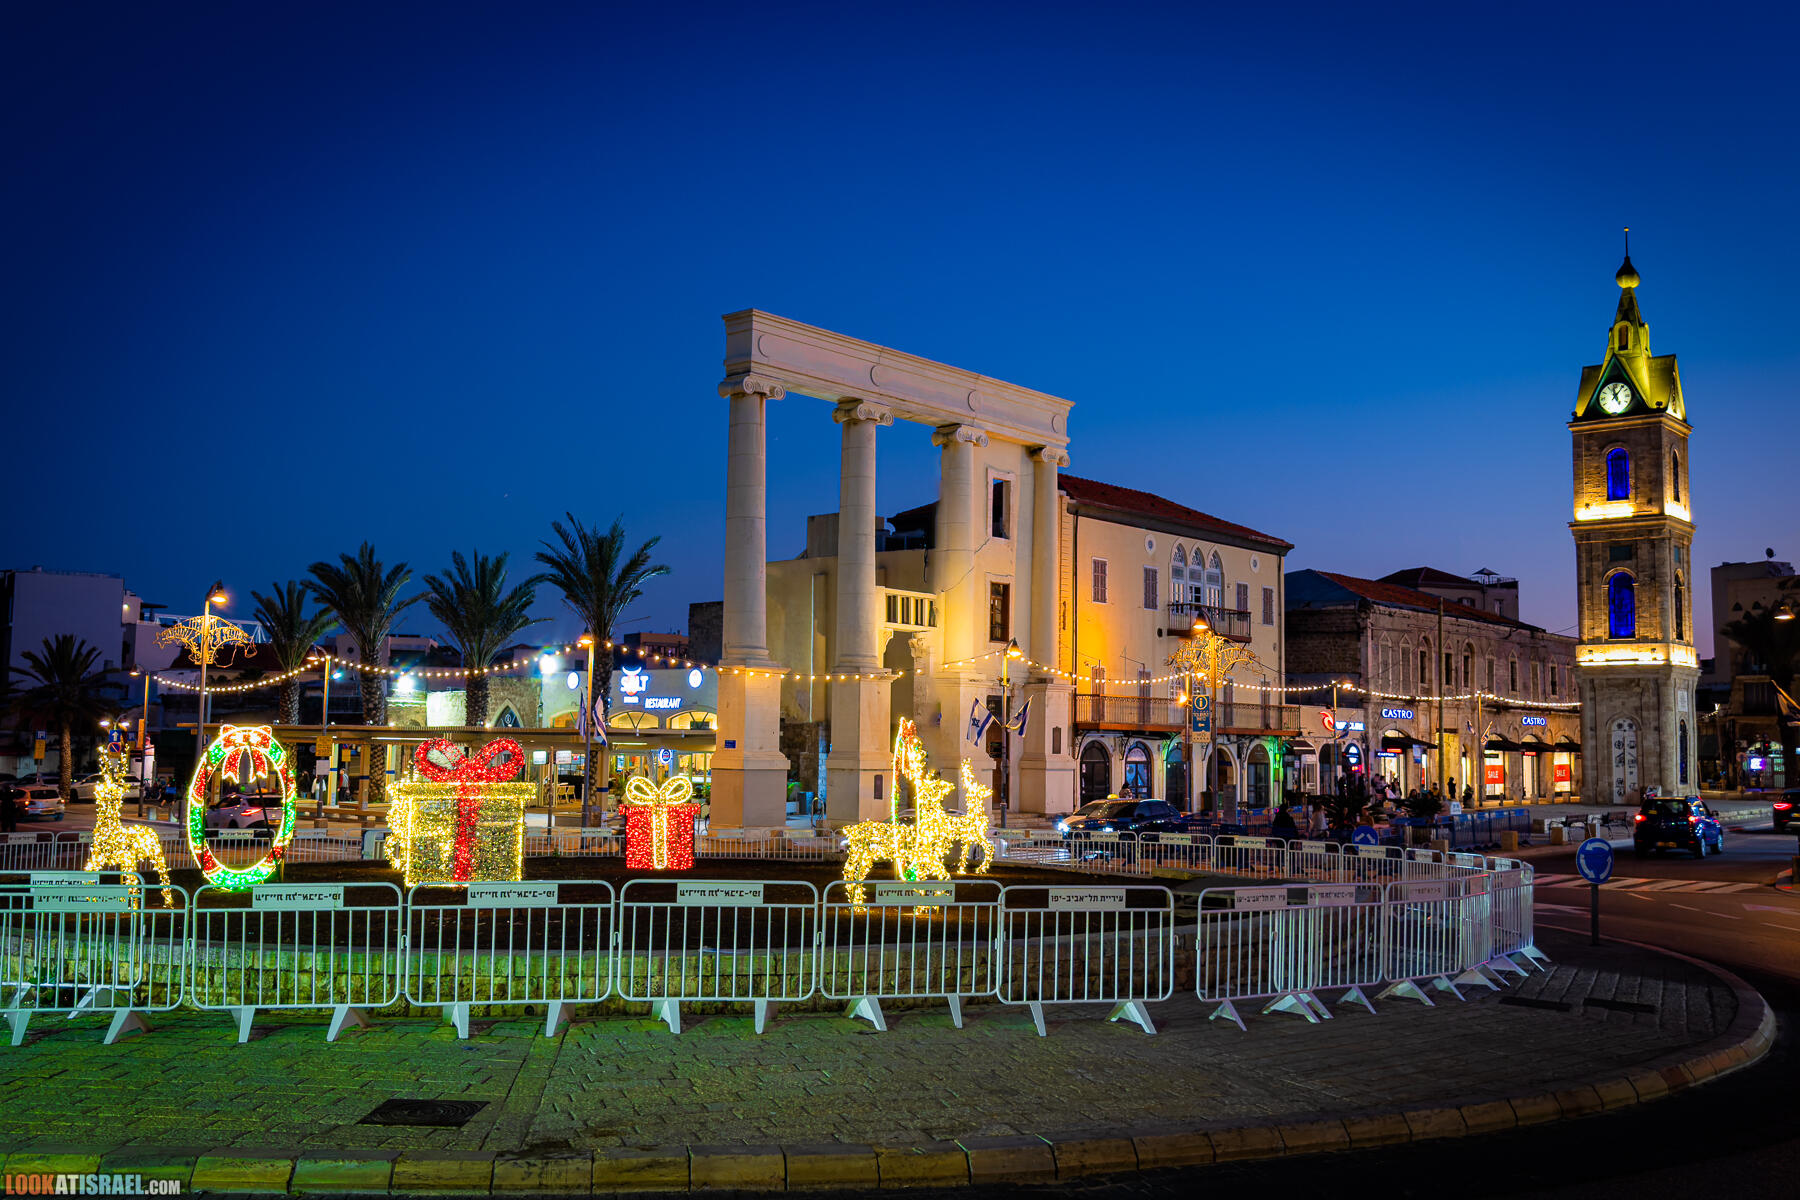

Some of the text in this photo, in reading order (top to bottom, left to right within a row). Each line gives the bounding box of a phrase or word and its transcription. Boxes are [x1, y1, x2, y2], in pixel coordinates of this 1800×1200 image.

[1382, 708, 1413, 719] CASTRO
[1522, 716, 1546, 726] CASTRO
[1488, 770, 1498, 778] SALE
